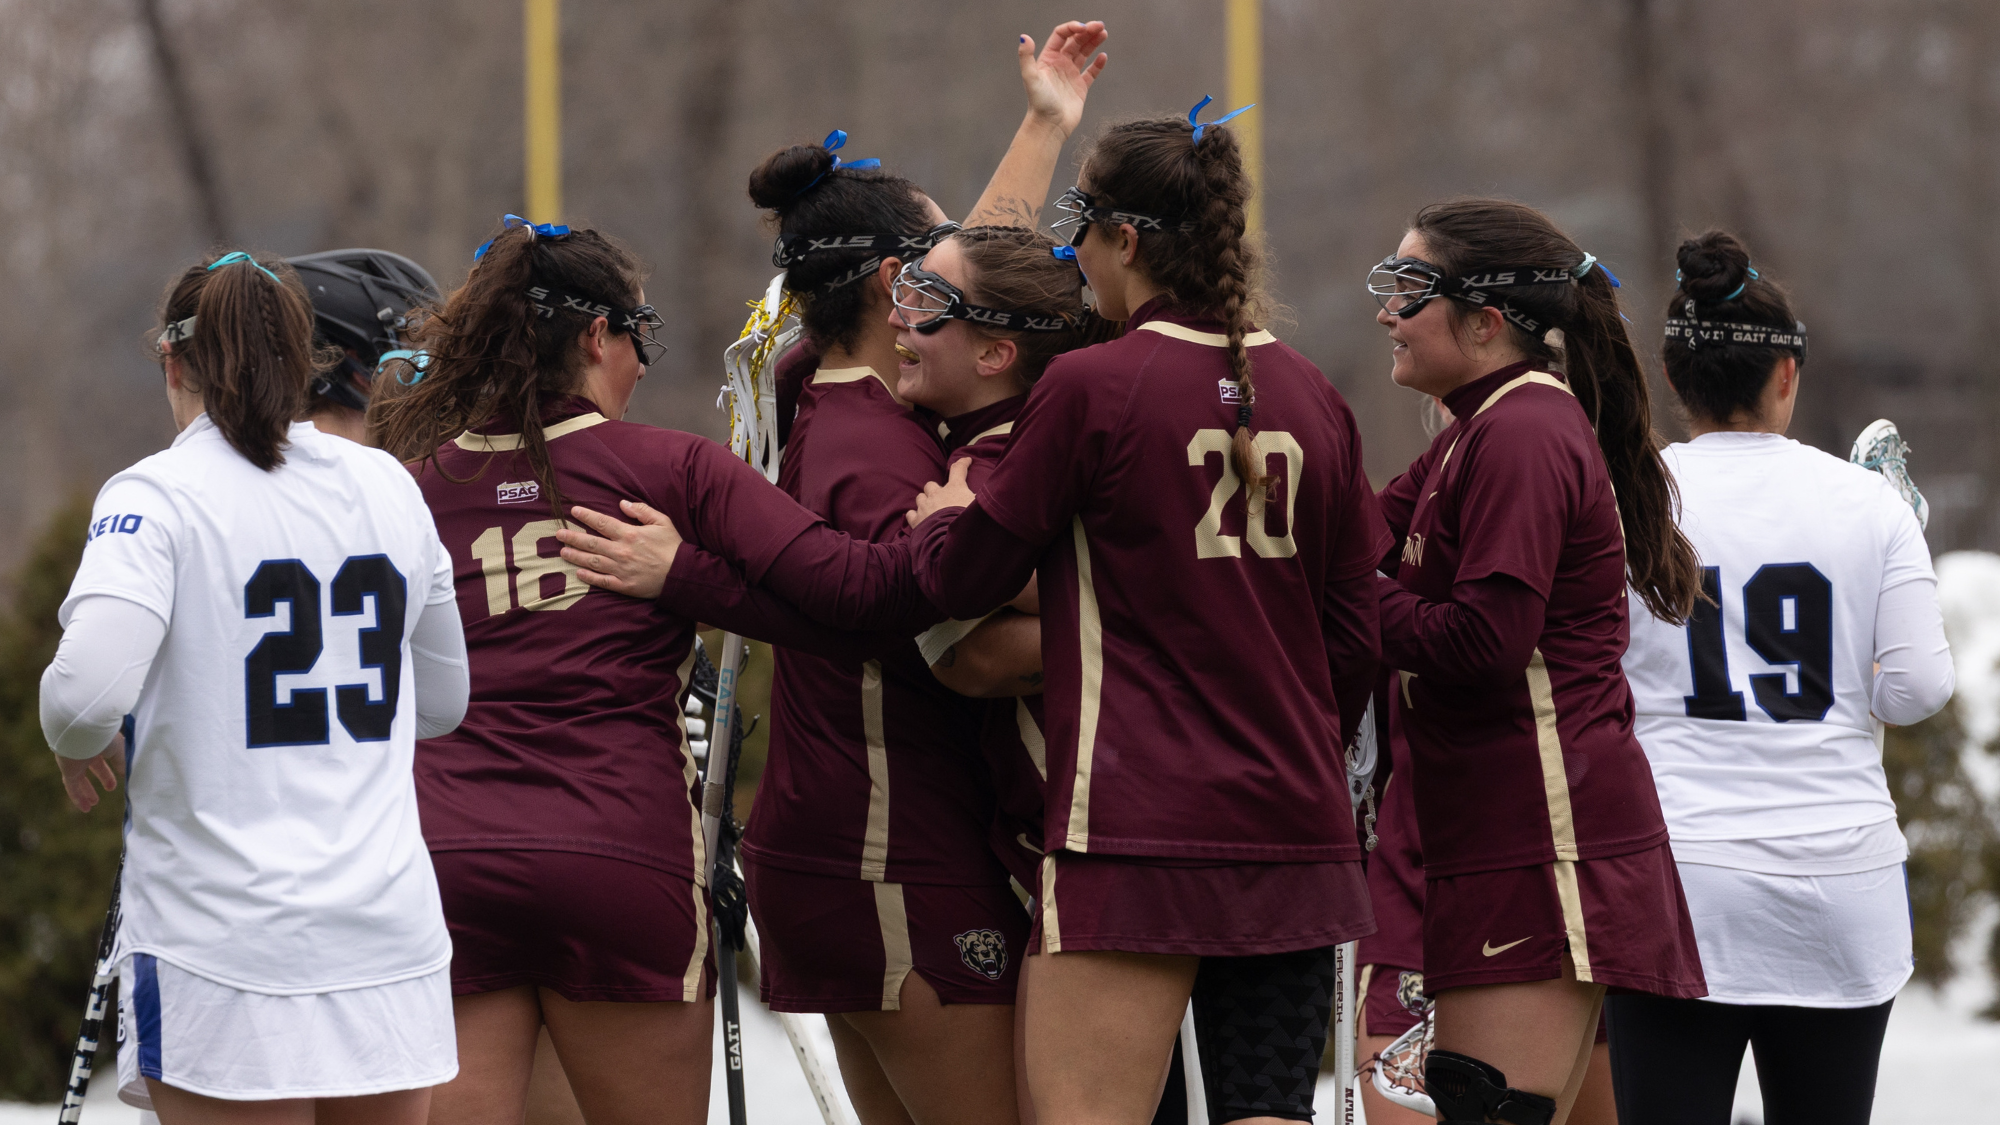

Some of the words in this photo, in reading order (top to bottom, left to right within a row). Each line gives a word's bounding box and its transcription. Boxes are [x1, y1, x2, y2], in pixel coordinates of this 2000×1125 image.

[1732, 331, 1767, 343] GAIT
[1770, 334, 1792, 346] GAIT
[498, 485, 538, 499] PSAC
[1186, 428, 1304, 560] 20
[470, 518, 591, 617] 18
[244, 553, 408, 750] 23
[1683, 561, 1836, 723] 19
[716, 667, 734, 729] GAIT
[1336, 948, 1344, 1024] MAVERIK
[727, 1020, 742, 1071] GAIT
